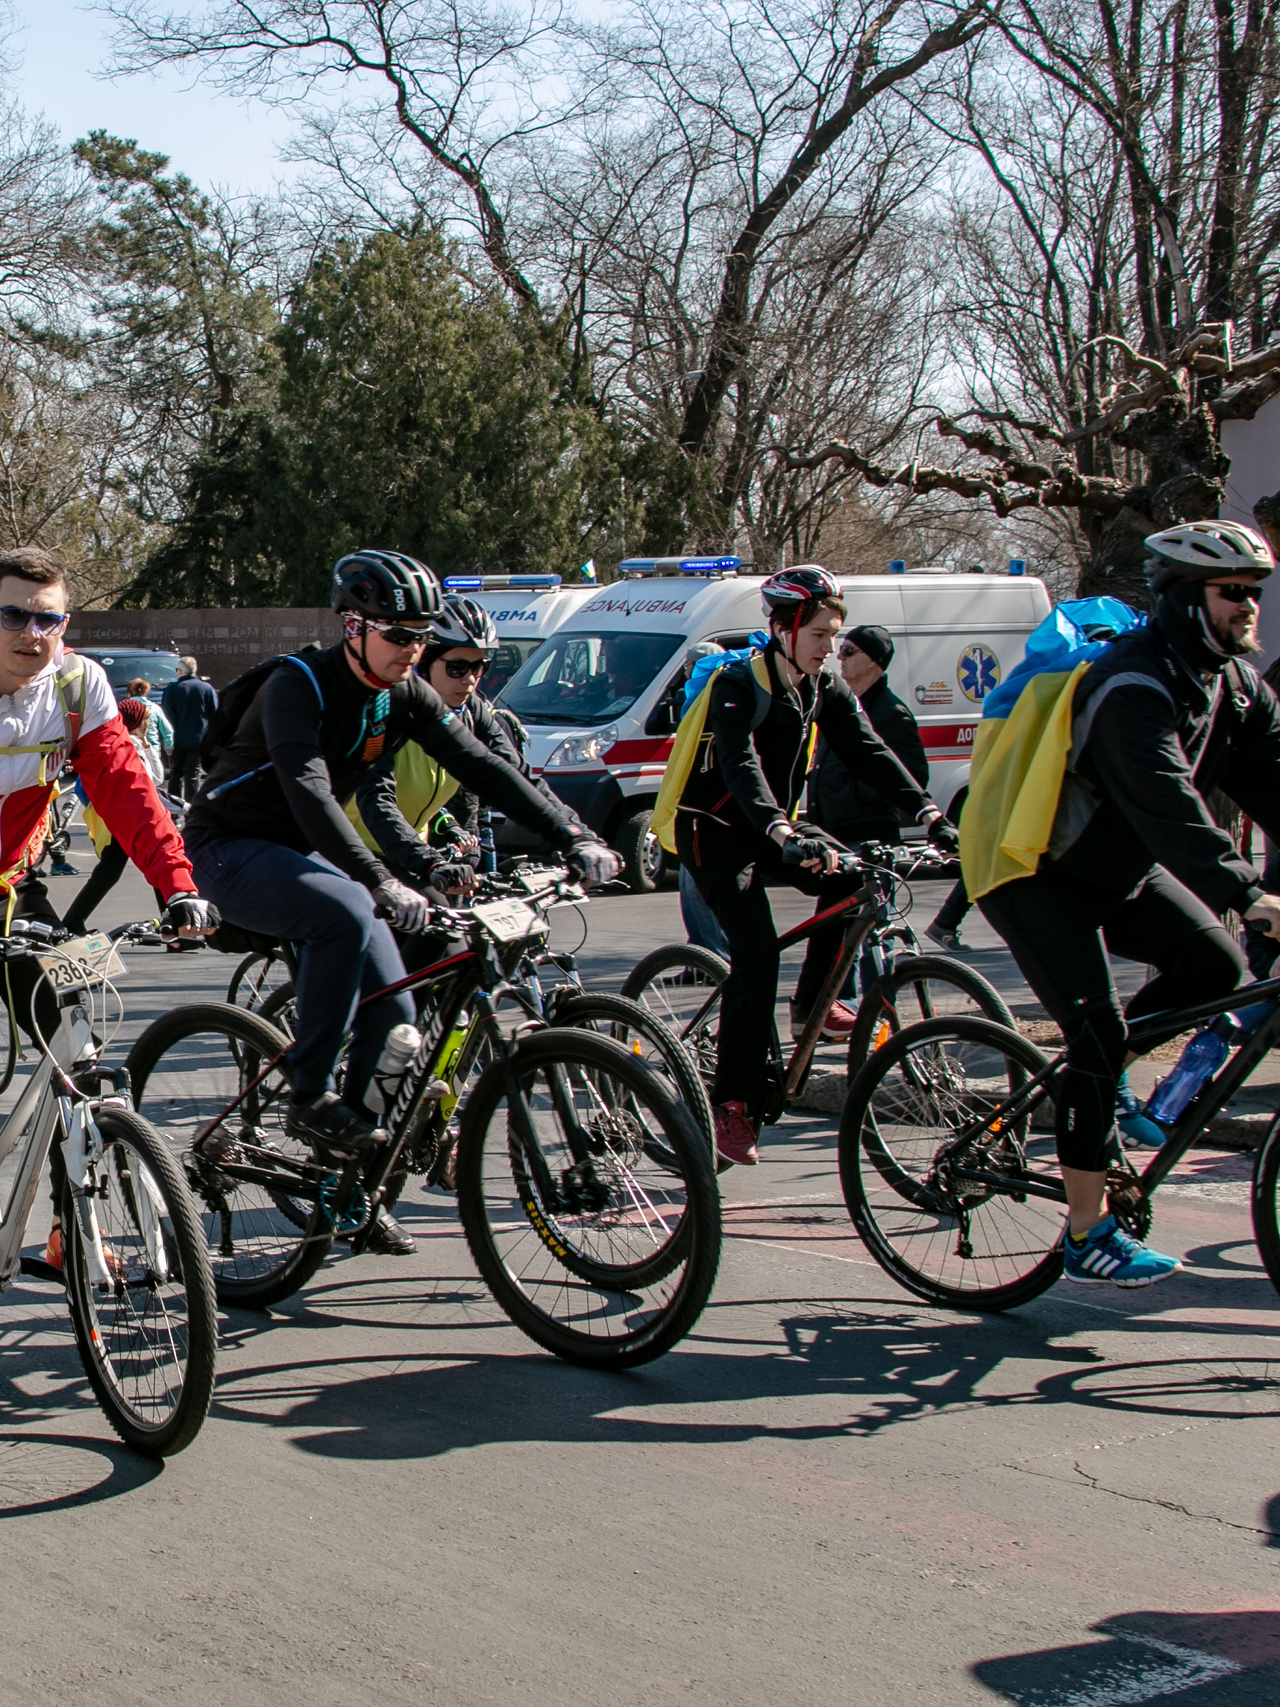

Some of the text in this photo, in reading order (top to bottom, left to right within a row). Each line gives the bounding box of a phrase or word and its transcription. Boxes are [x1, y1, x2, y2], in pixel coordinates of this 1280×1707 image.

[188, 627, 214, 639] ВАМ
[228, 626, 282, 639] РОДИНА
[526, 1200, 567, 1257] MAXXIS
